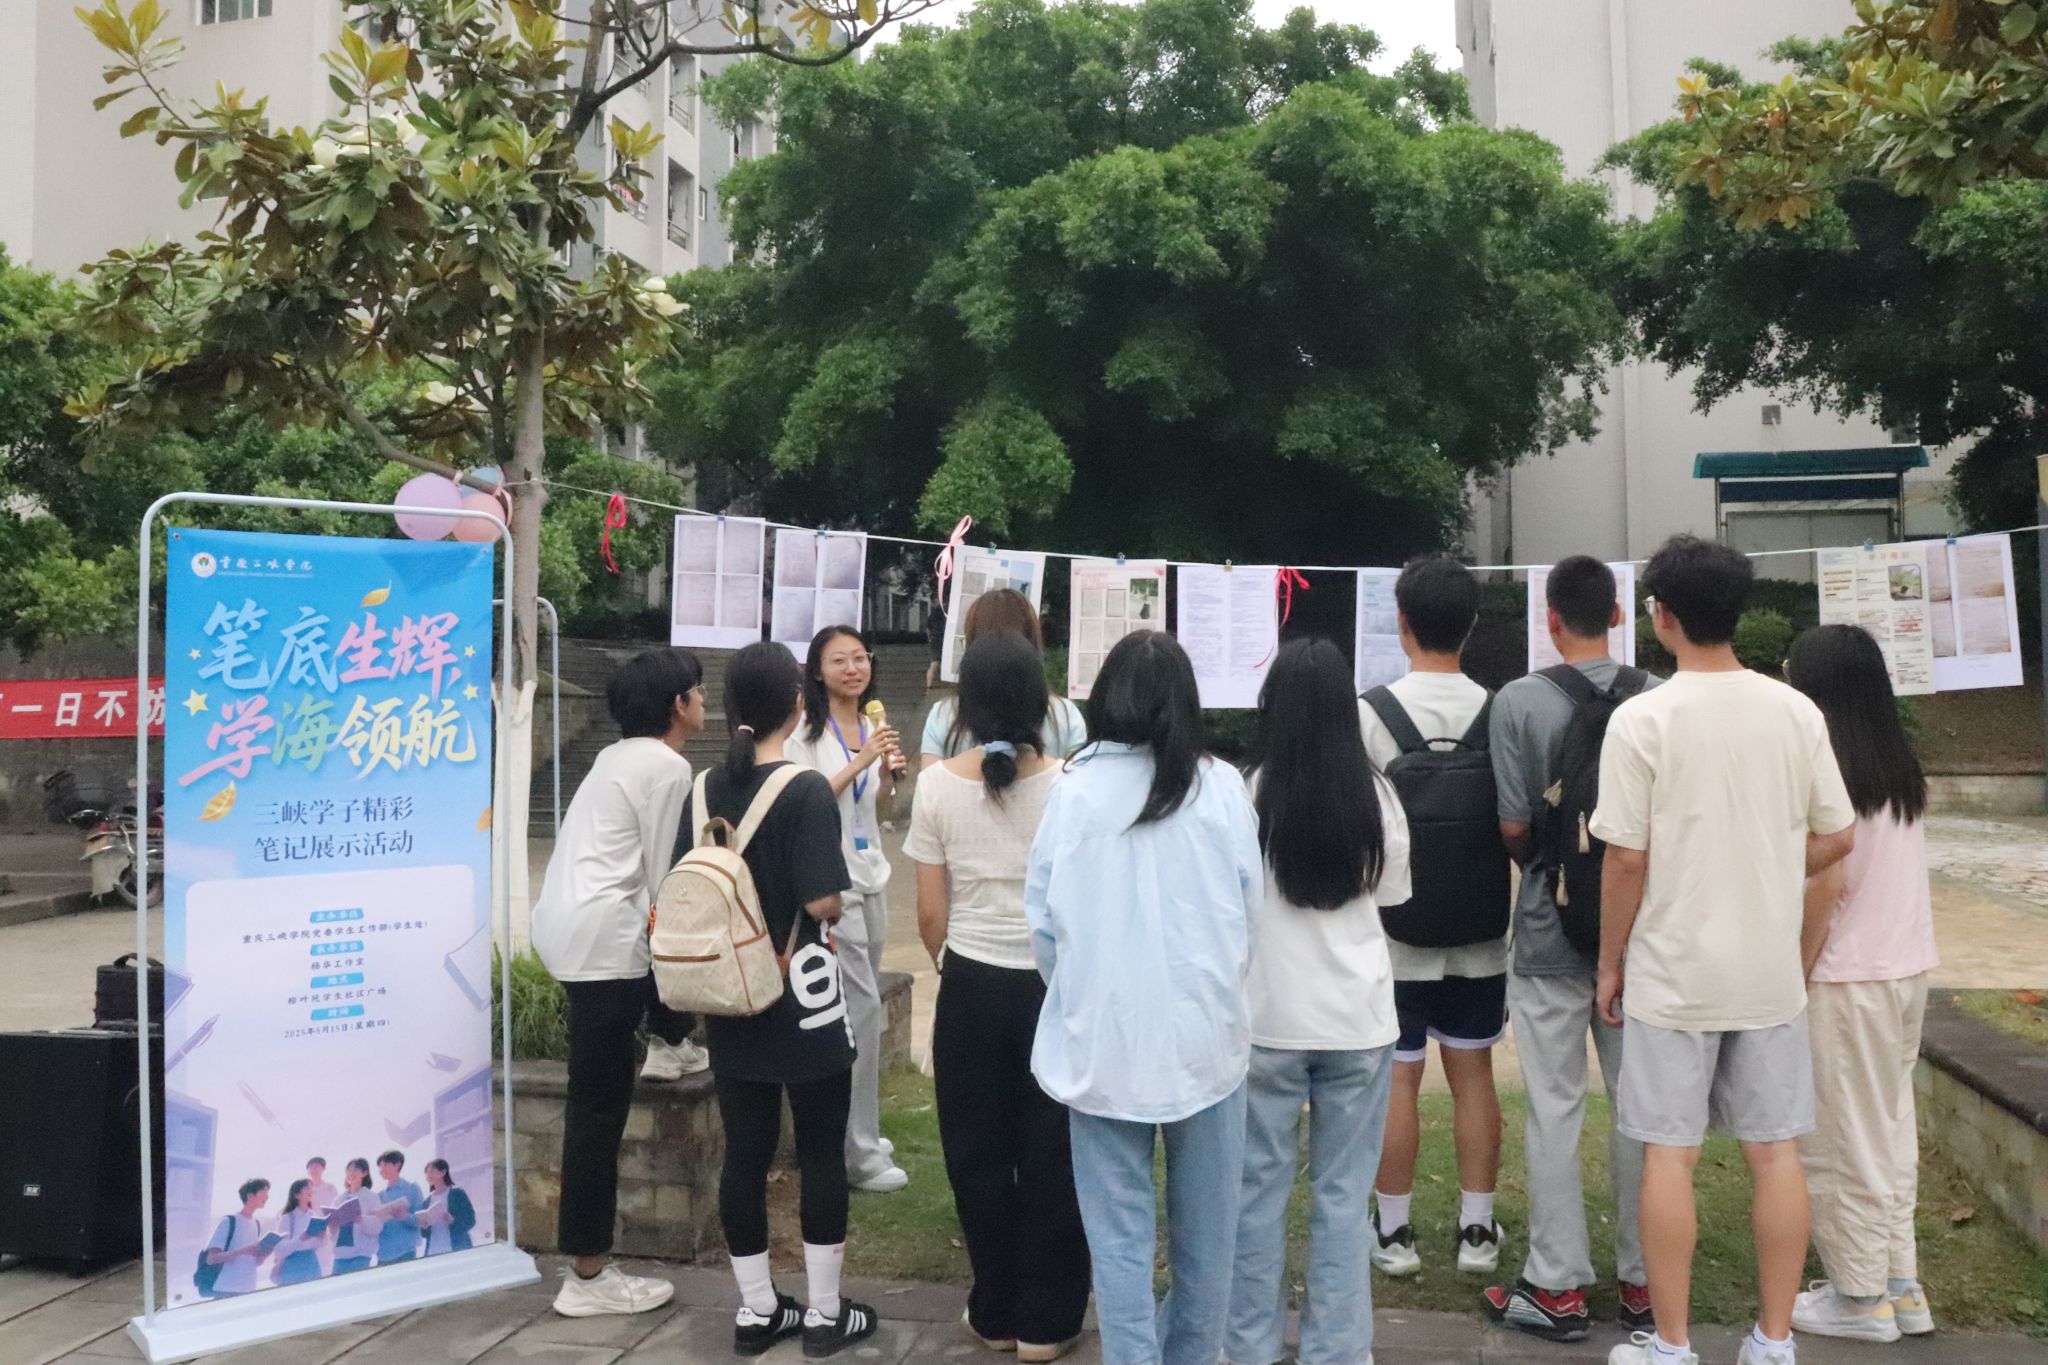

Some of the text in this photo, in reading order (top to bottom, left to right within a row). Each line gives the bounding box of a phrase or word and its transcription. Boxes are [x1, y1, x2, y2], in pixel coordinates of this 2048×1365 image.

[0, 687, 165, 728] 一日不防
[179, 693, 477, 787] 学海领航
[255, 796, 414, 826] 三峡学子精彩
[254, 830, 413, 862] 笔记展示活动
[327, 975, 350, 986] 地点
[327, 1007, 350, 1018] 时间
